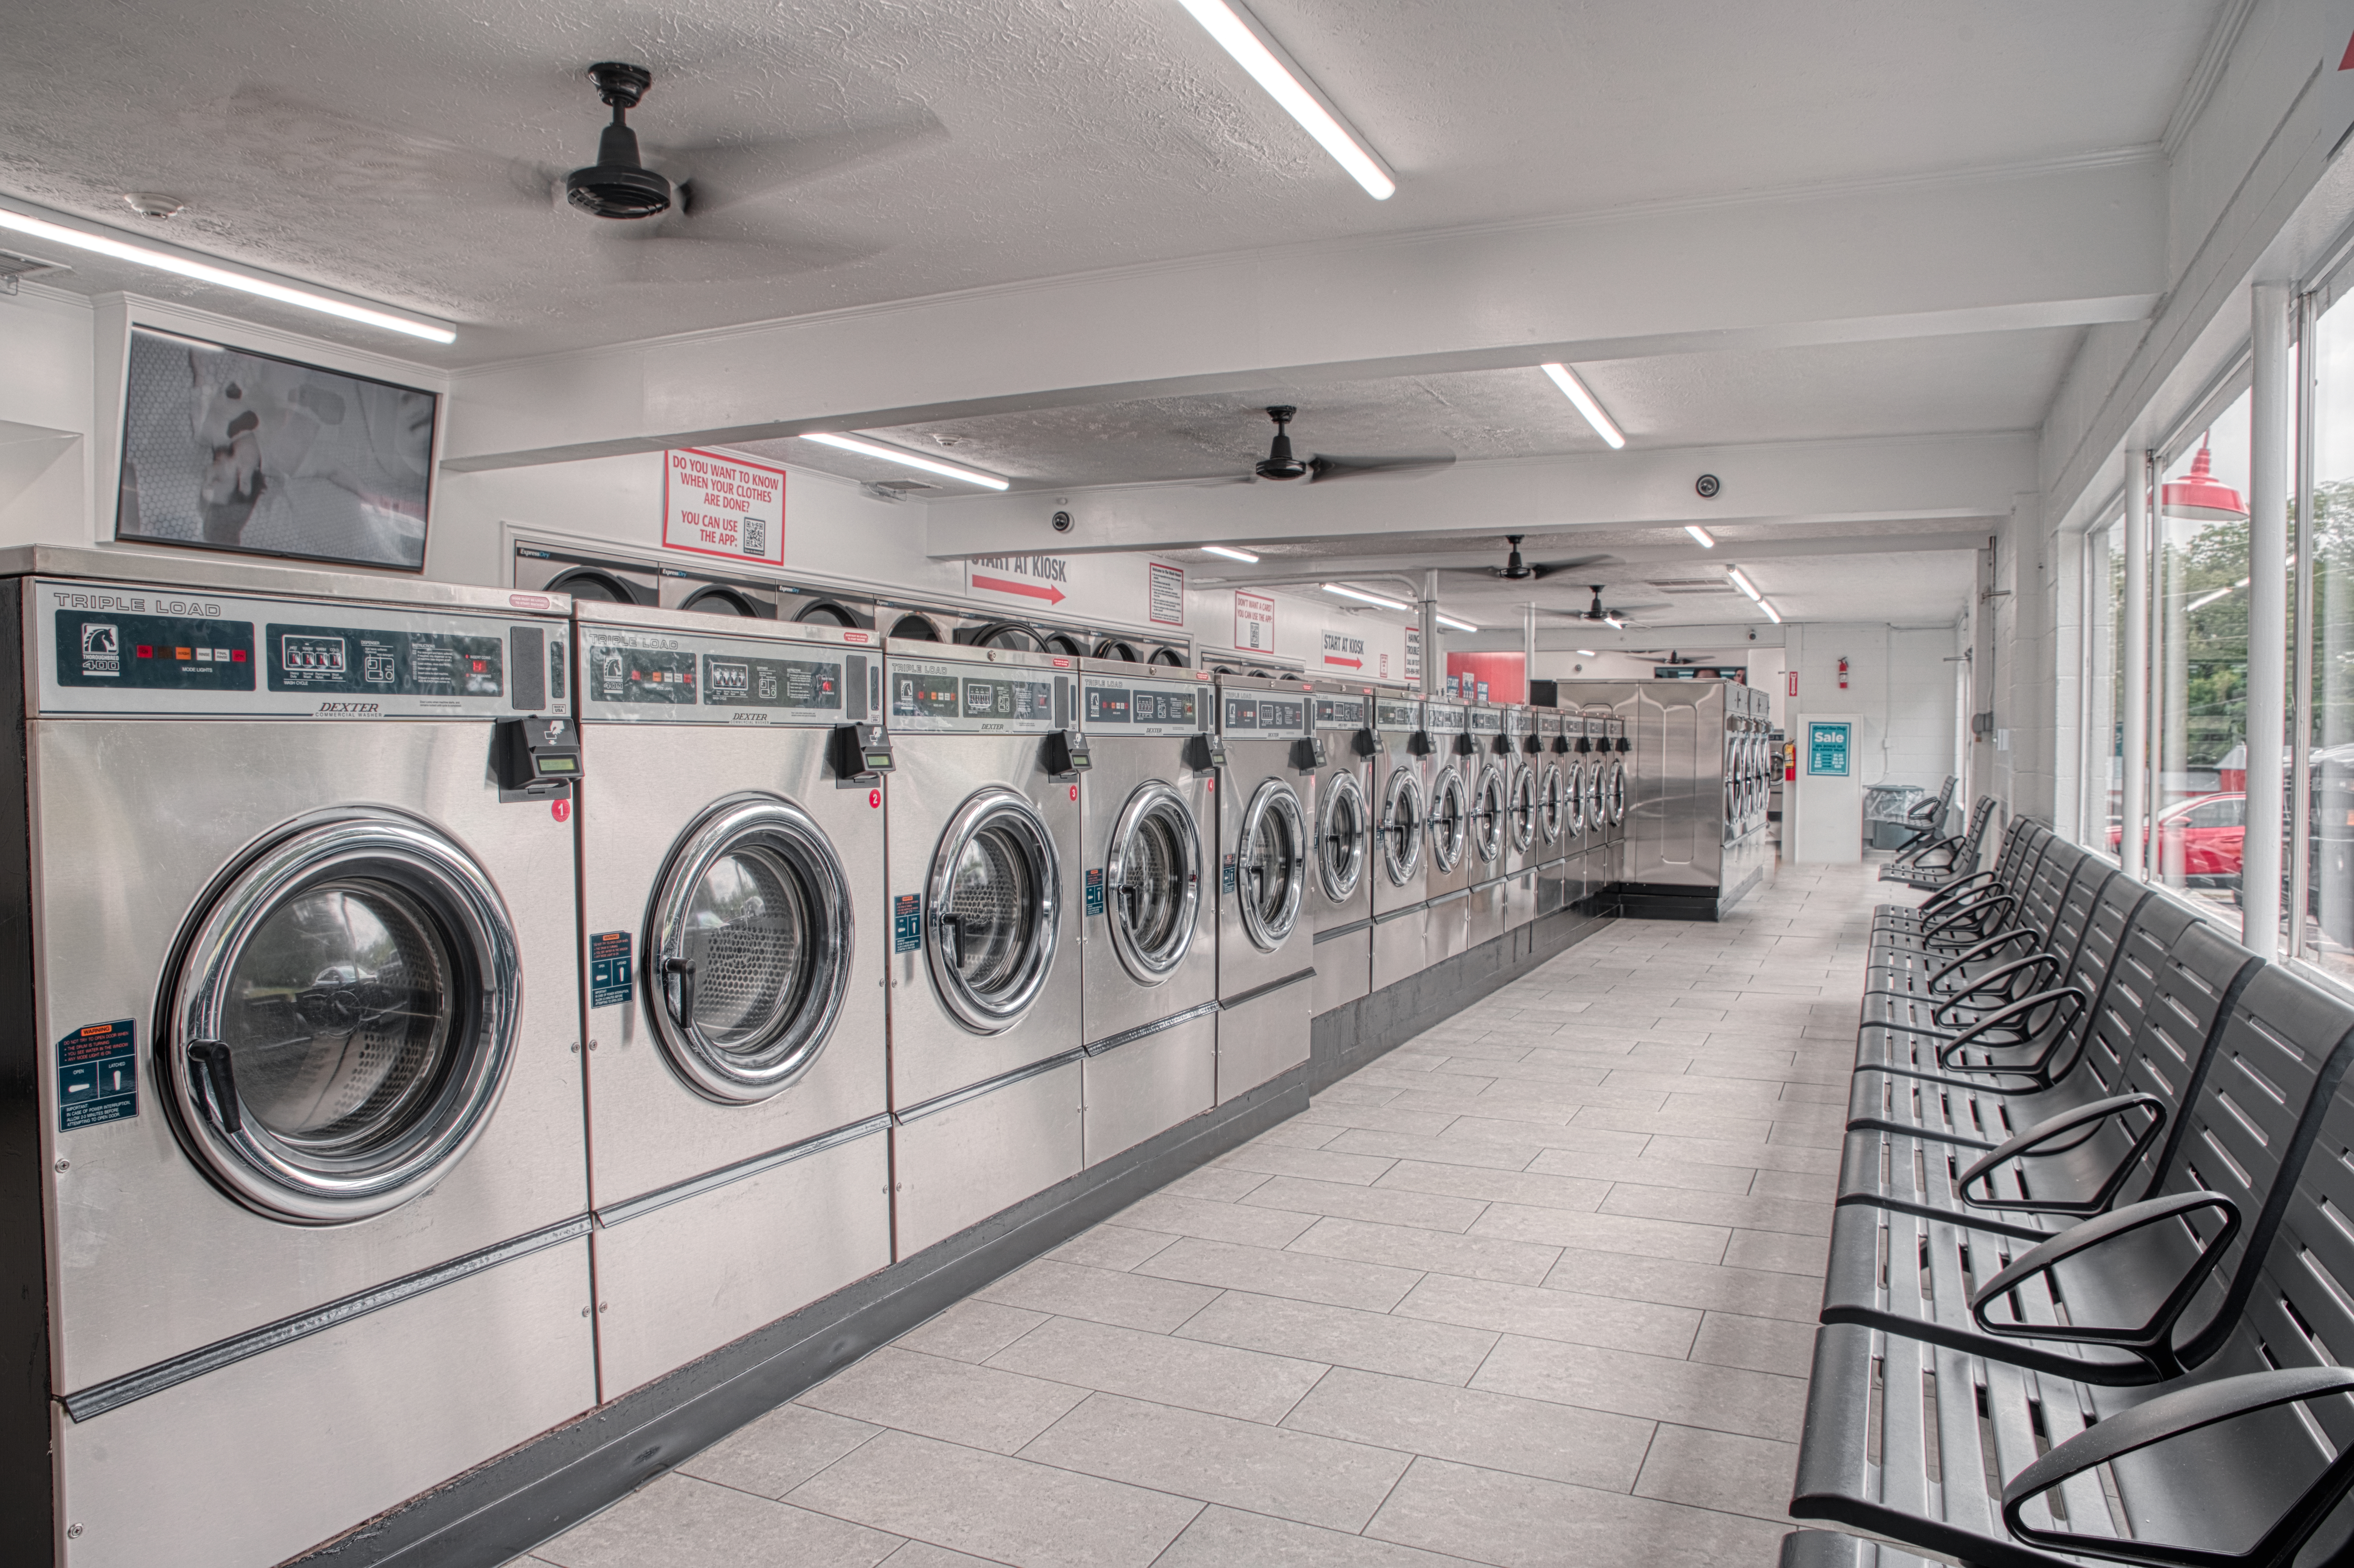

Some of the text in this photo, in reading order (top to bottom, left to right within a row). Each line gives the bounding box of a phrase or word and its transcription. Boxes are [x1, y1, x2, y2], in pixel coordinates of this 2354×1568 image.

[673, 455, 779, 490] DO YOU WANT TO KNOW
[681, 472, 771, 503] WHEN YOUR CLOTHES
[704, 493, 750, 513] ARE DONE?
[681, 510, 738, 532] YOU CAN USE
[700, 529, 738, 547] THE APP:
[520, 548, 550, 559] ExpressDry
[662, 568, 687, 578] ExpressDry
[1033, 555, 1067, 582] KIOSK
[779, 585, 800, 593] ExpressDry
[54, 593, 220, 617] TRIPLE LOAD
[1238, 598, 1248, 607] DON'T
[1249, 600, 1259, 609] WANT
[590, 634, 678, 650] TRIPLE LOAD
[1325, 634, 1364, 654] START AT KIOSK
[83, 661, 120, 670] 400
[892, 663, 947, 674] TRIPLE LOAD
[319, 702, 378, 712] DEXTER
[1814, 732, 1844, 743] Sale
[873, 794, 877, 803] 2
[558, 803, 563, 815] 1
[104, 1101, 131, 1110] INTERRUPTION,
